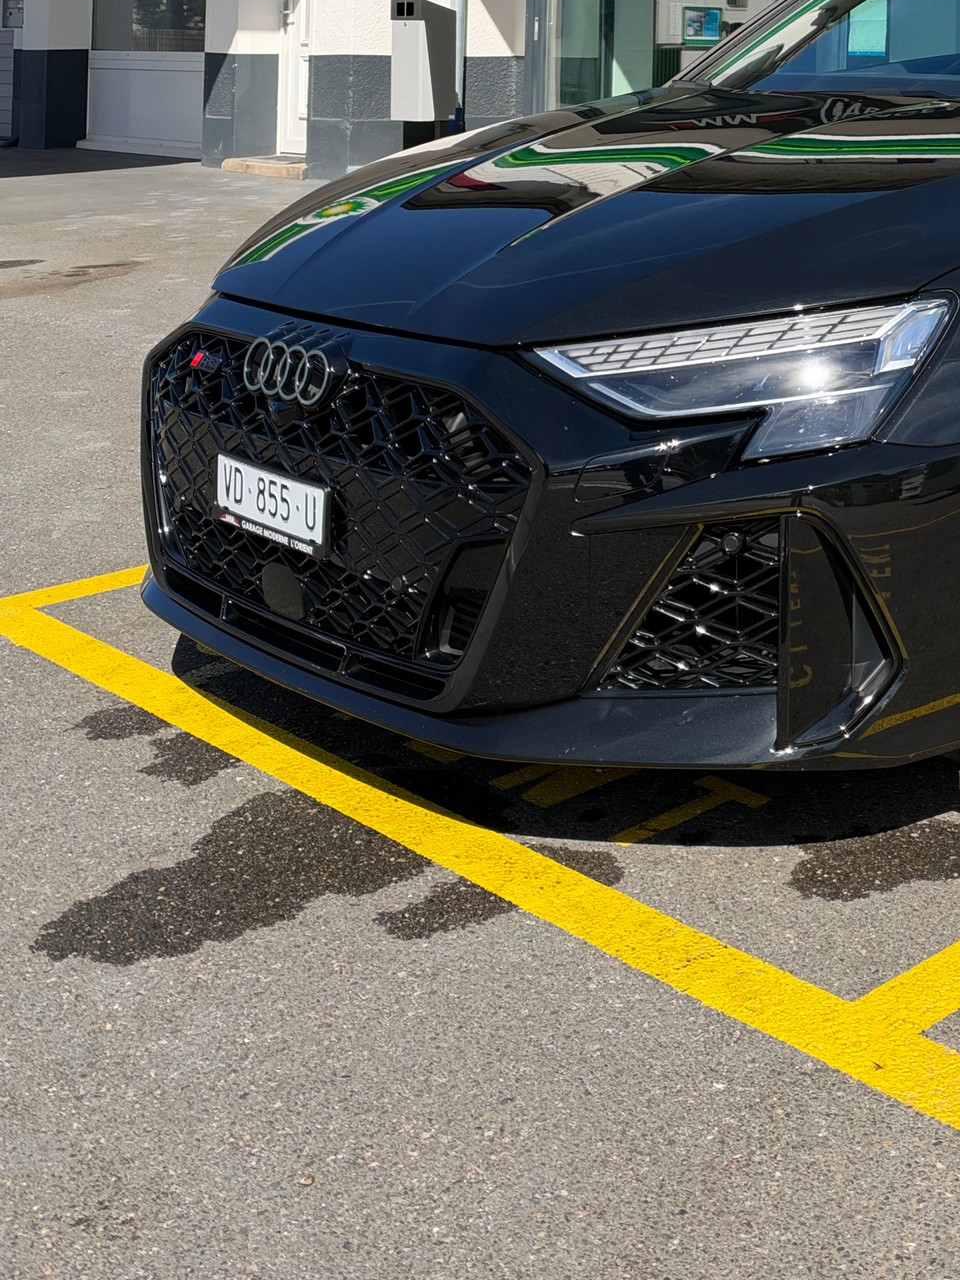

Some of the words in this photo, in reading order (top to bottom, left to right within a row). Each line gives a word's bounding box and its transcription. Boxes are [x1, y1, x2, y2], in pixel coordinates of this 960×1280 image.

[224, 462, 244, 504] VD
[256, 476, 291, 521] 855
[305, 492, 317, 531] U
[241, 520, 263, 535] GARAGE
[263, 528, 289, 545] MODERNE
[290, 538, 314, 555] L'ORIENT
